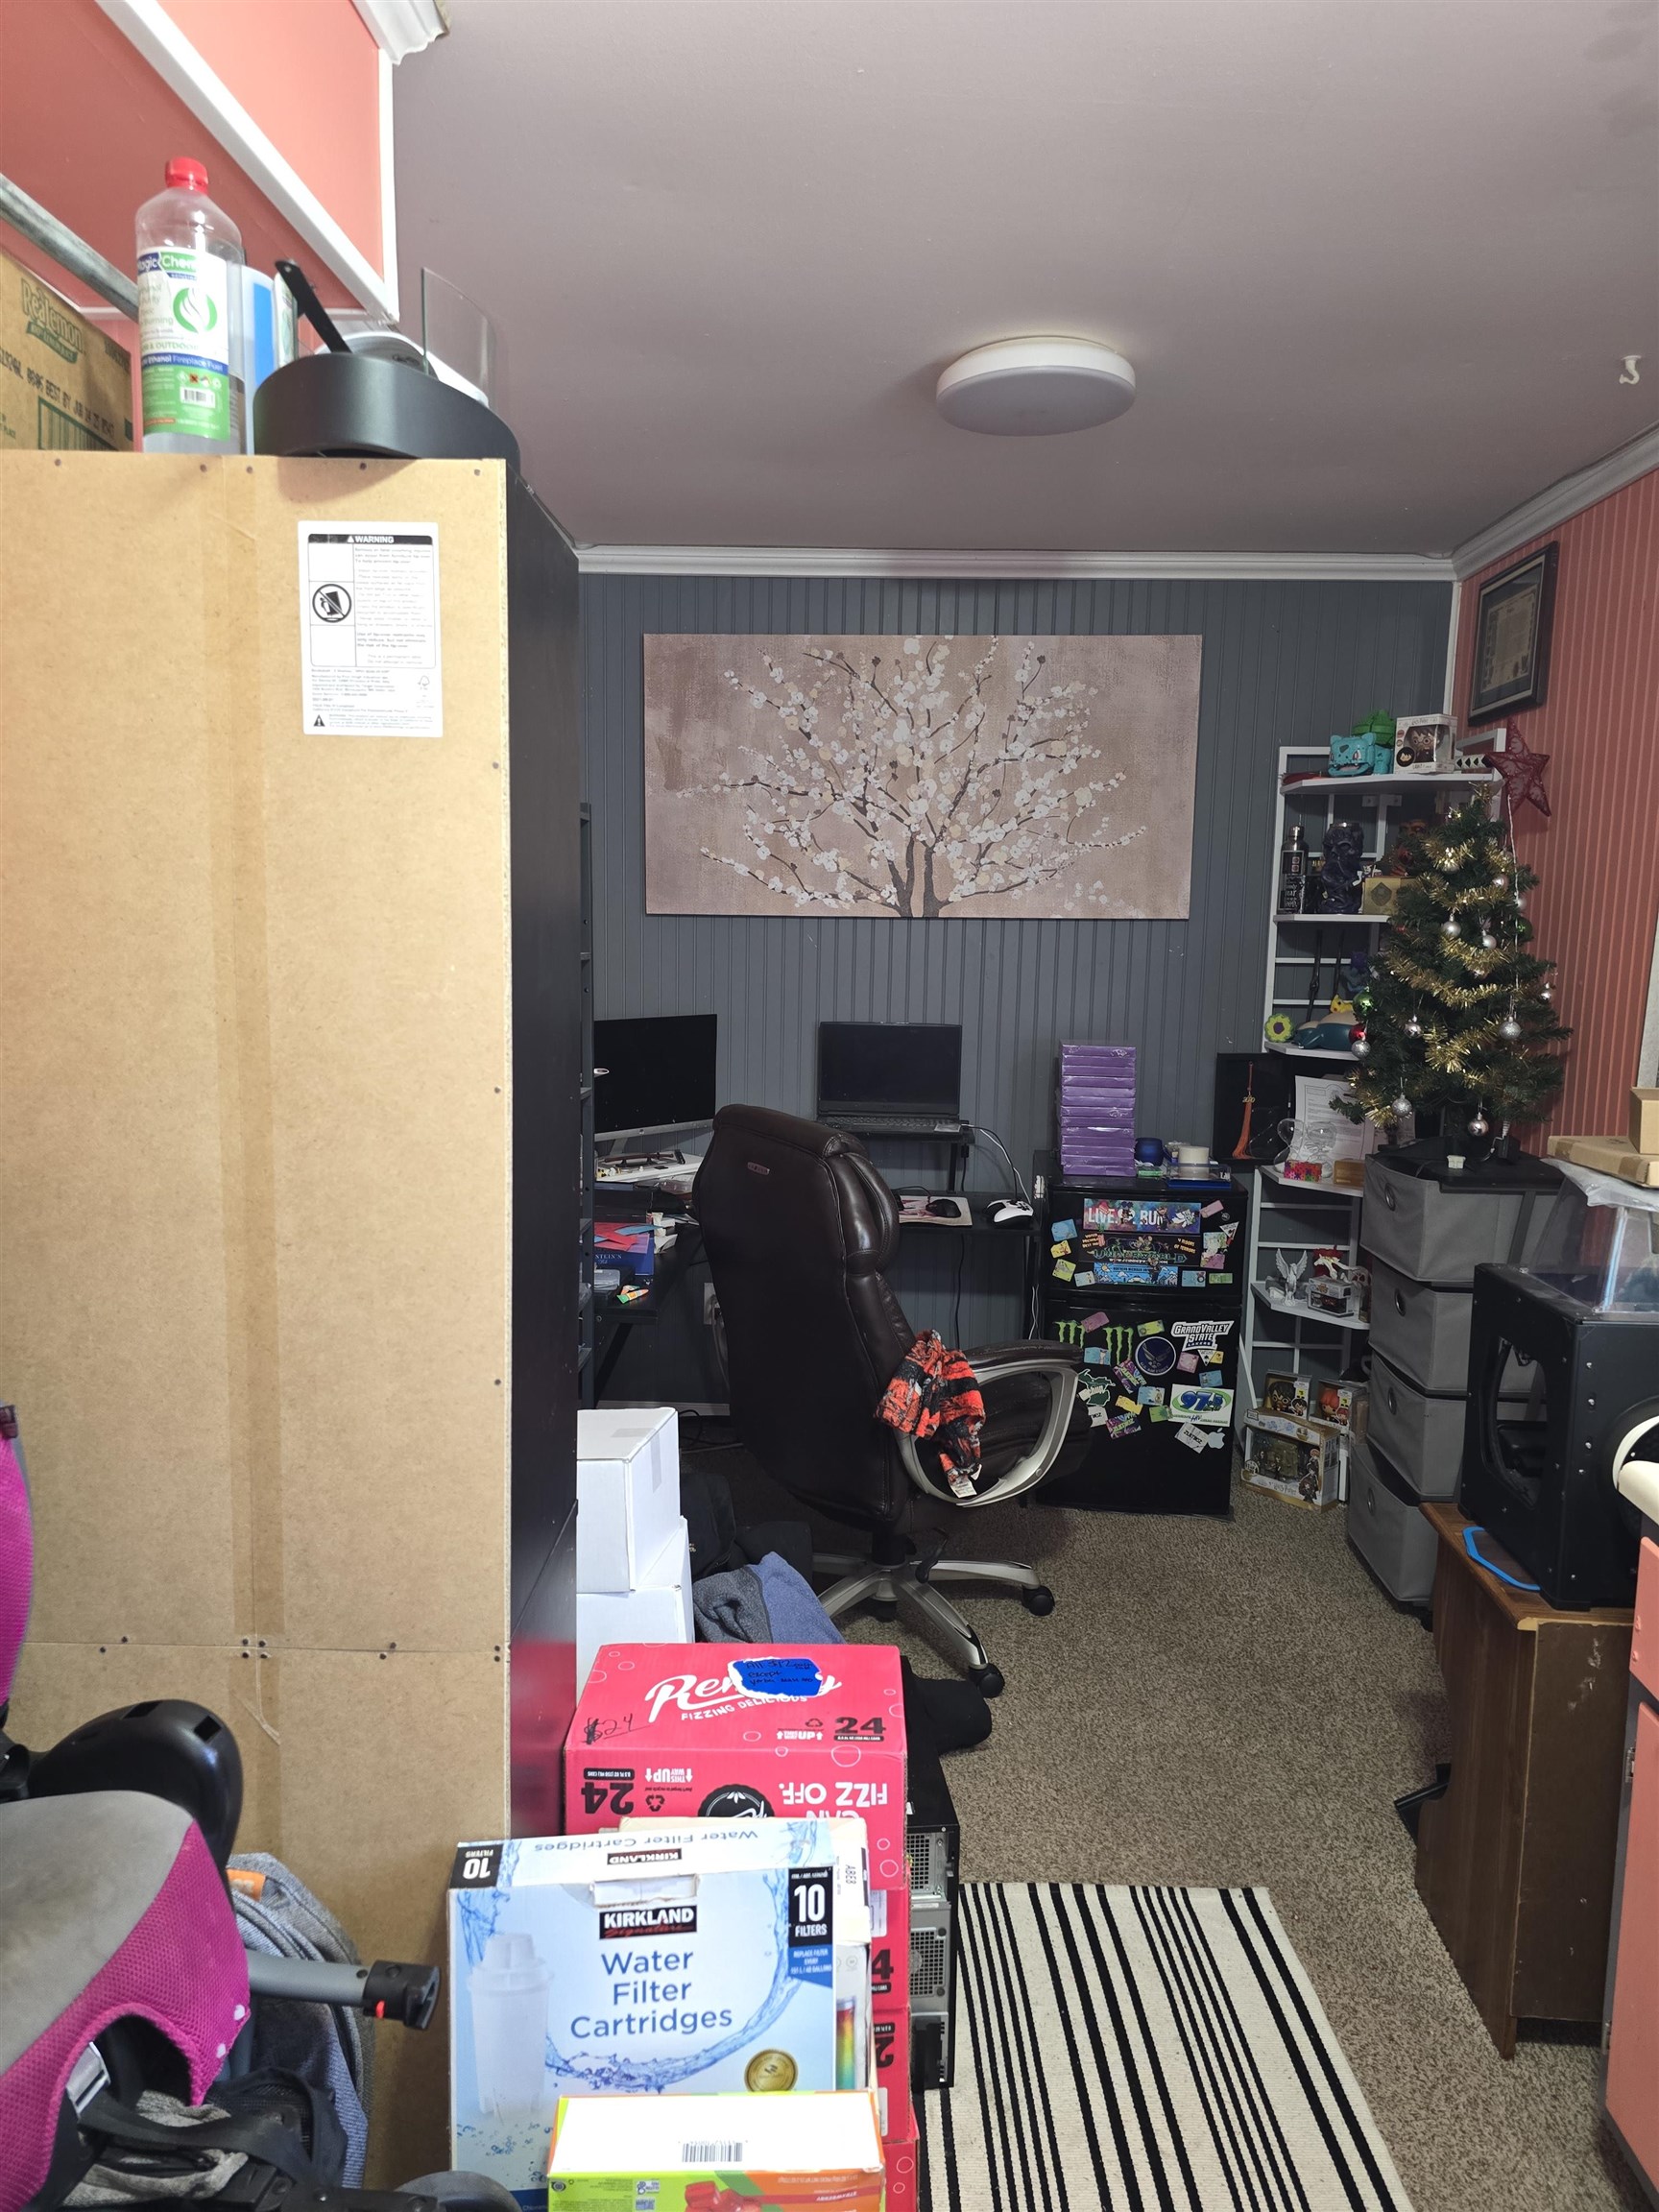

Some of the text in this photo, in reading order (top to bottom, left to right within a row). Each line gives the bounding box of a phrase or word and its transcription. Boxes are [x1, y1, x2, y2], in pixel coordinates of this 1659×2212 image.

[1188, 1333, 1214, 1343] STATE
[681, 1703, 735, 1721] FIZZING
[798, 1731, 816, 1740] UP
[834, 1717, 887, 1734] 24
[653, 1768, 671, 1783] UP
[581, 1782, 635, 1815] 24
[779, 1782, 889, 1808] FIZZ OFF.
[534, 1830, 758, 1852] Water Filter Cartridges
[610, 1851, 680, 1864] KIRKLAND
[462, 1859, 492, 1879] 10
[794, 1883, 826, 1923] 10
[604, 1907, 694, 1930] KIRKLAND
[795, 1923, 828, 1937] FILTERS
[601, 1950, 694, 1976] Water
[871, 1948, 894, 1981] 4
[613, 1980, 692, 2006] Filter
[570, 2008, 733, 2039] Cartridges
[875, 2035, 895, 2068] 2
